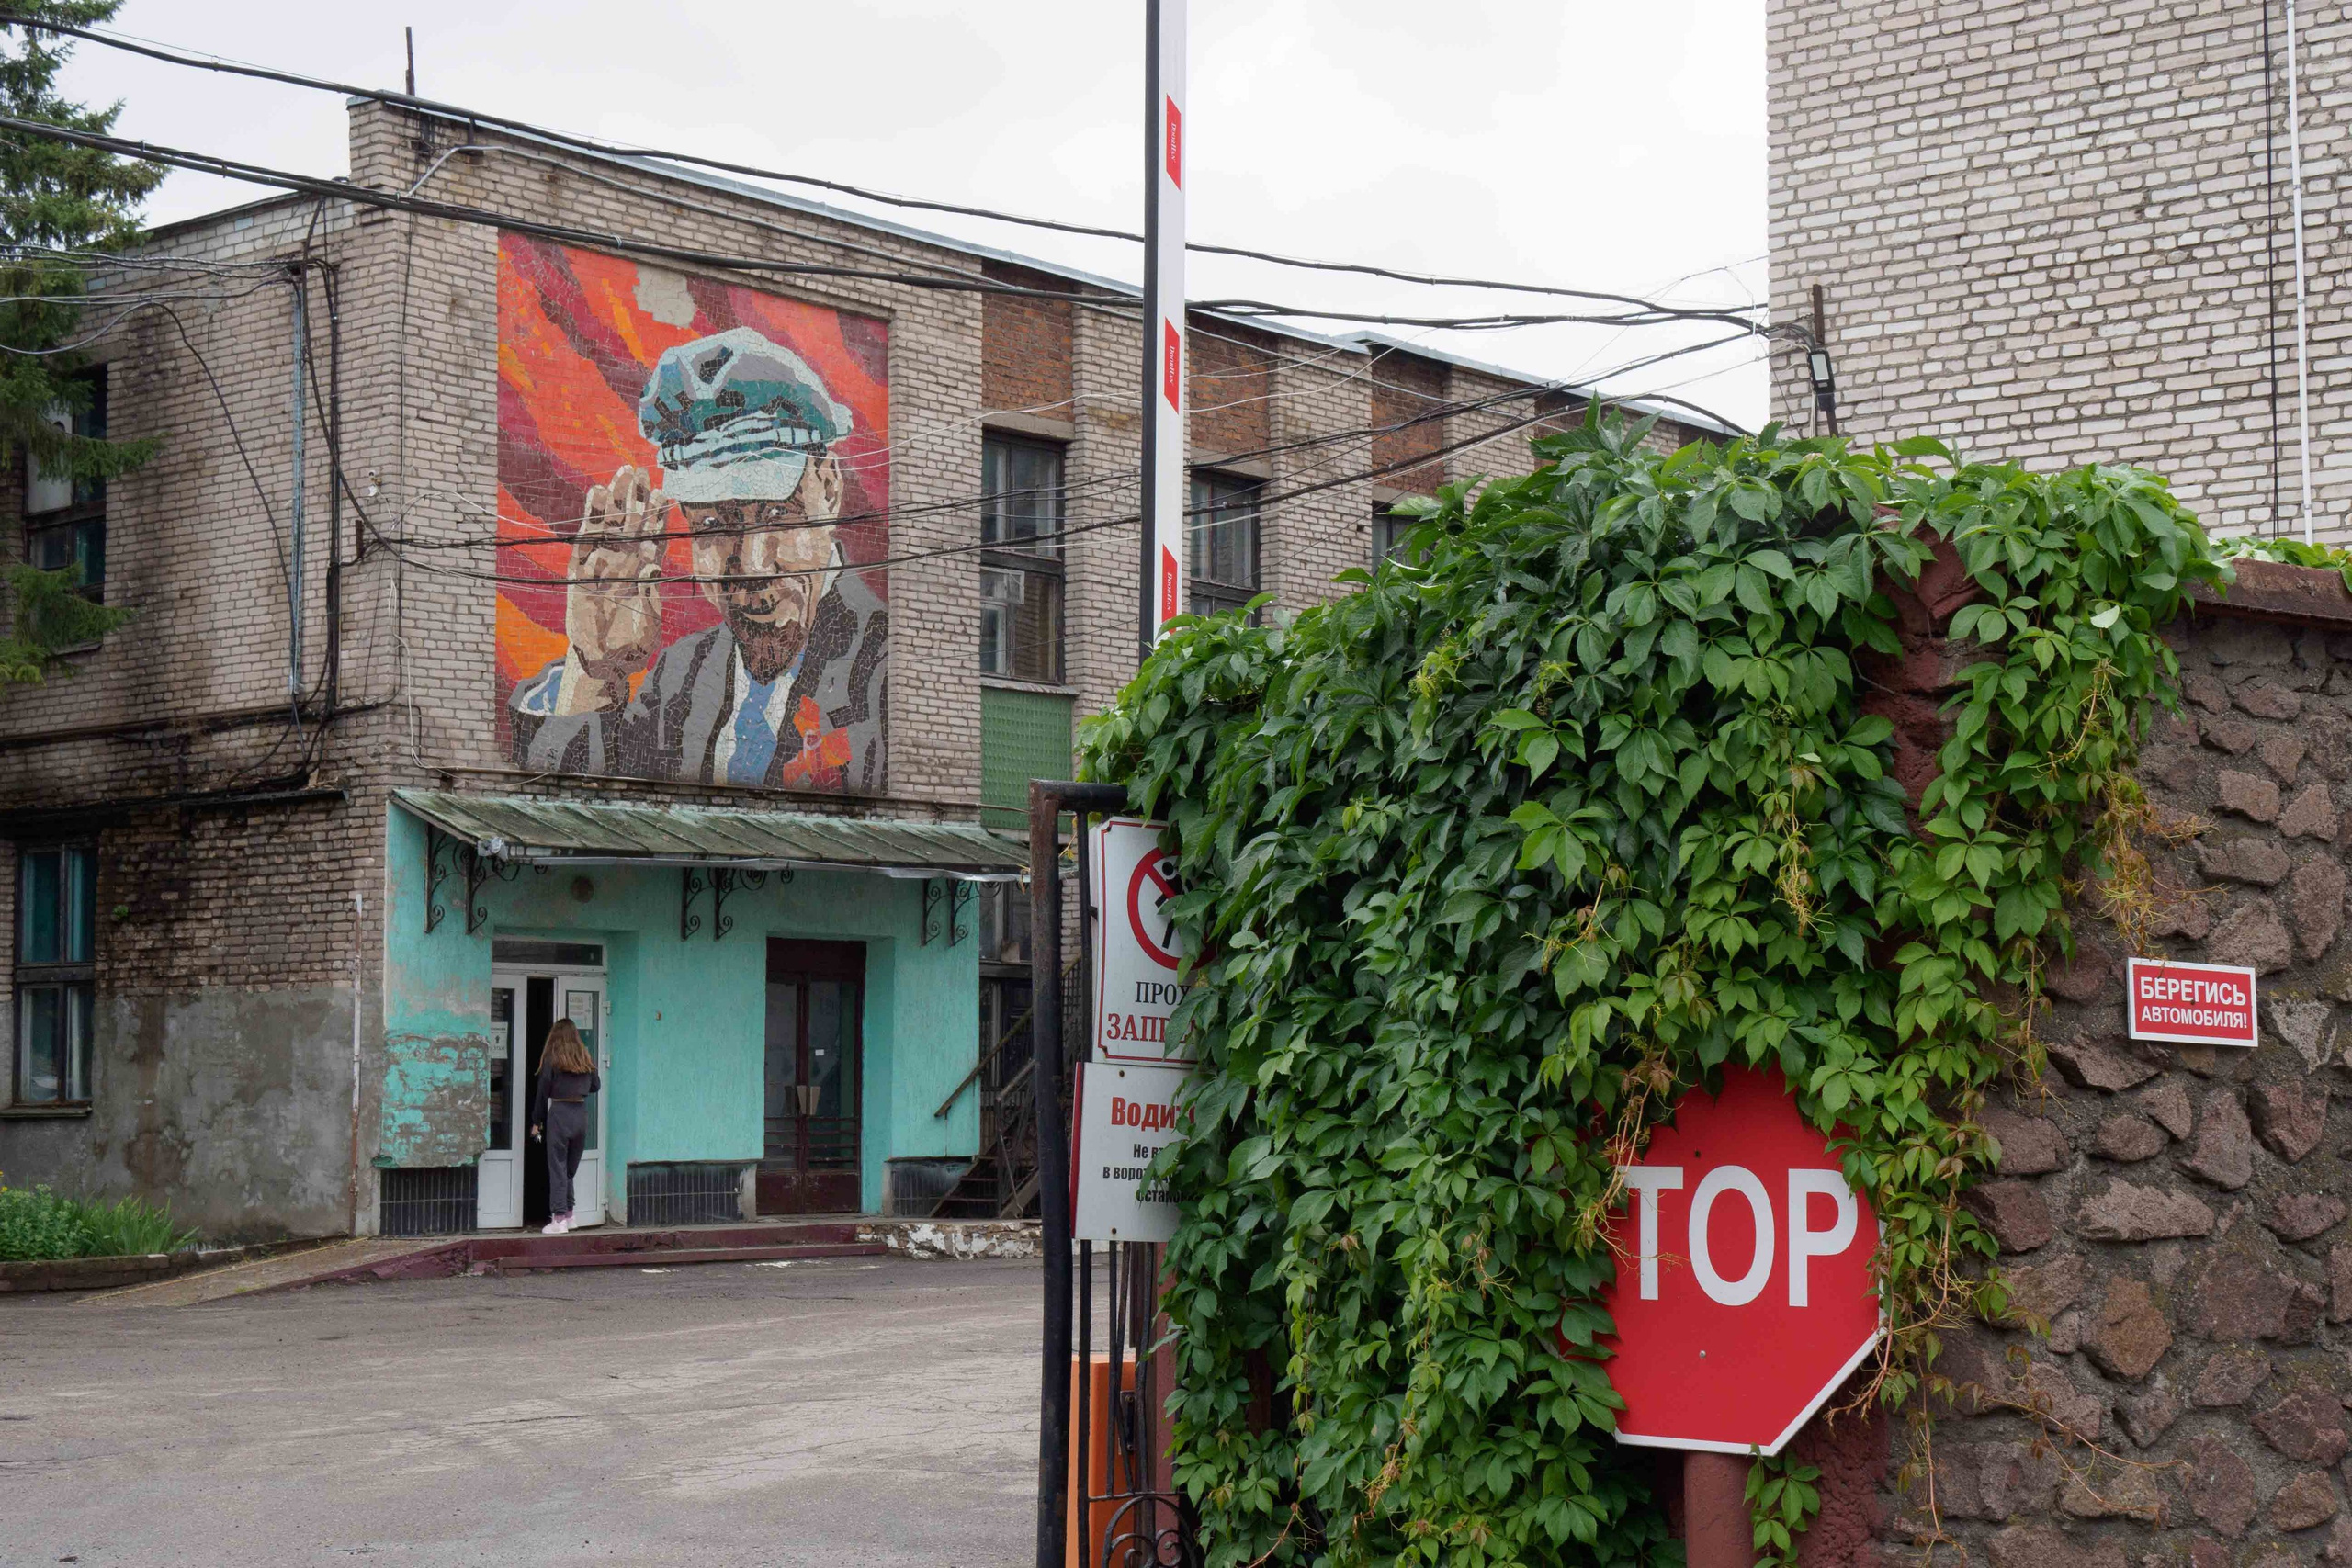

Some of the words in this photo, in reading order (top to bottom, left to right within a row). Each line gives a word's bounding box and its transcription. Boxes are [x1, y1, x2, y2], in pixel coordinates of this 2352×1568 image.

[1135, 981, 1192, 1006] ПРОХ
[2140, 976, 2246, 1006] БЕРЕГИСЬ
[2141, 1006, 2247, 1029] АВТОМОБИЛЯ!
[1111, 1097, 1181, 1132] Води
[1133, 1144, 1148, 1158] Не
[1102, 1167, 1111, 1179] в
[1113, 1167, 1146, 1181] воро
[1618, 1165, 1859, 1307] TOP
